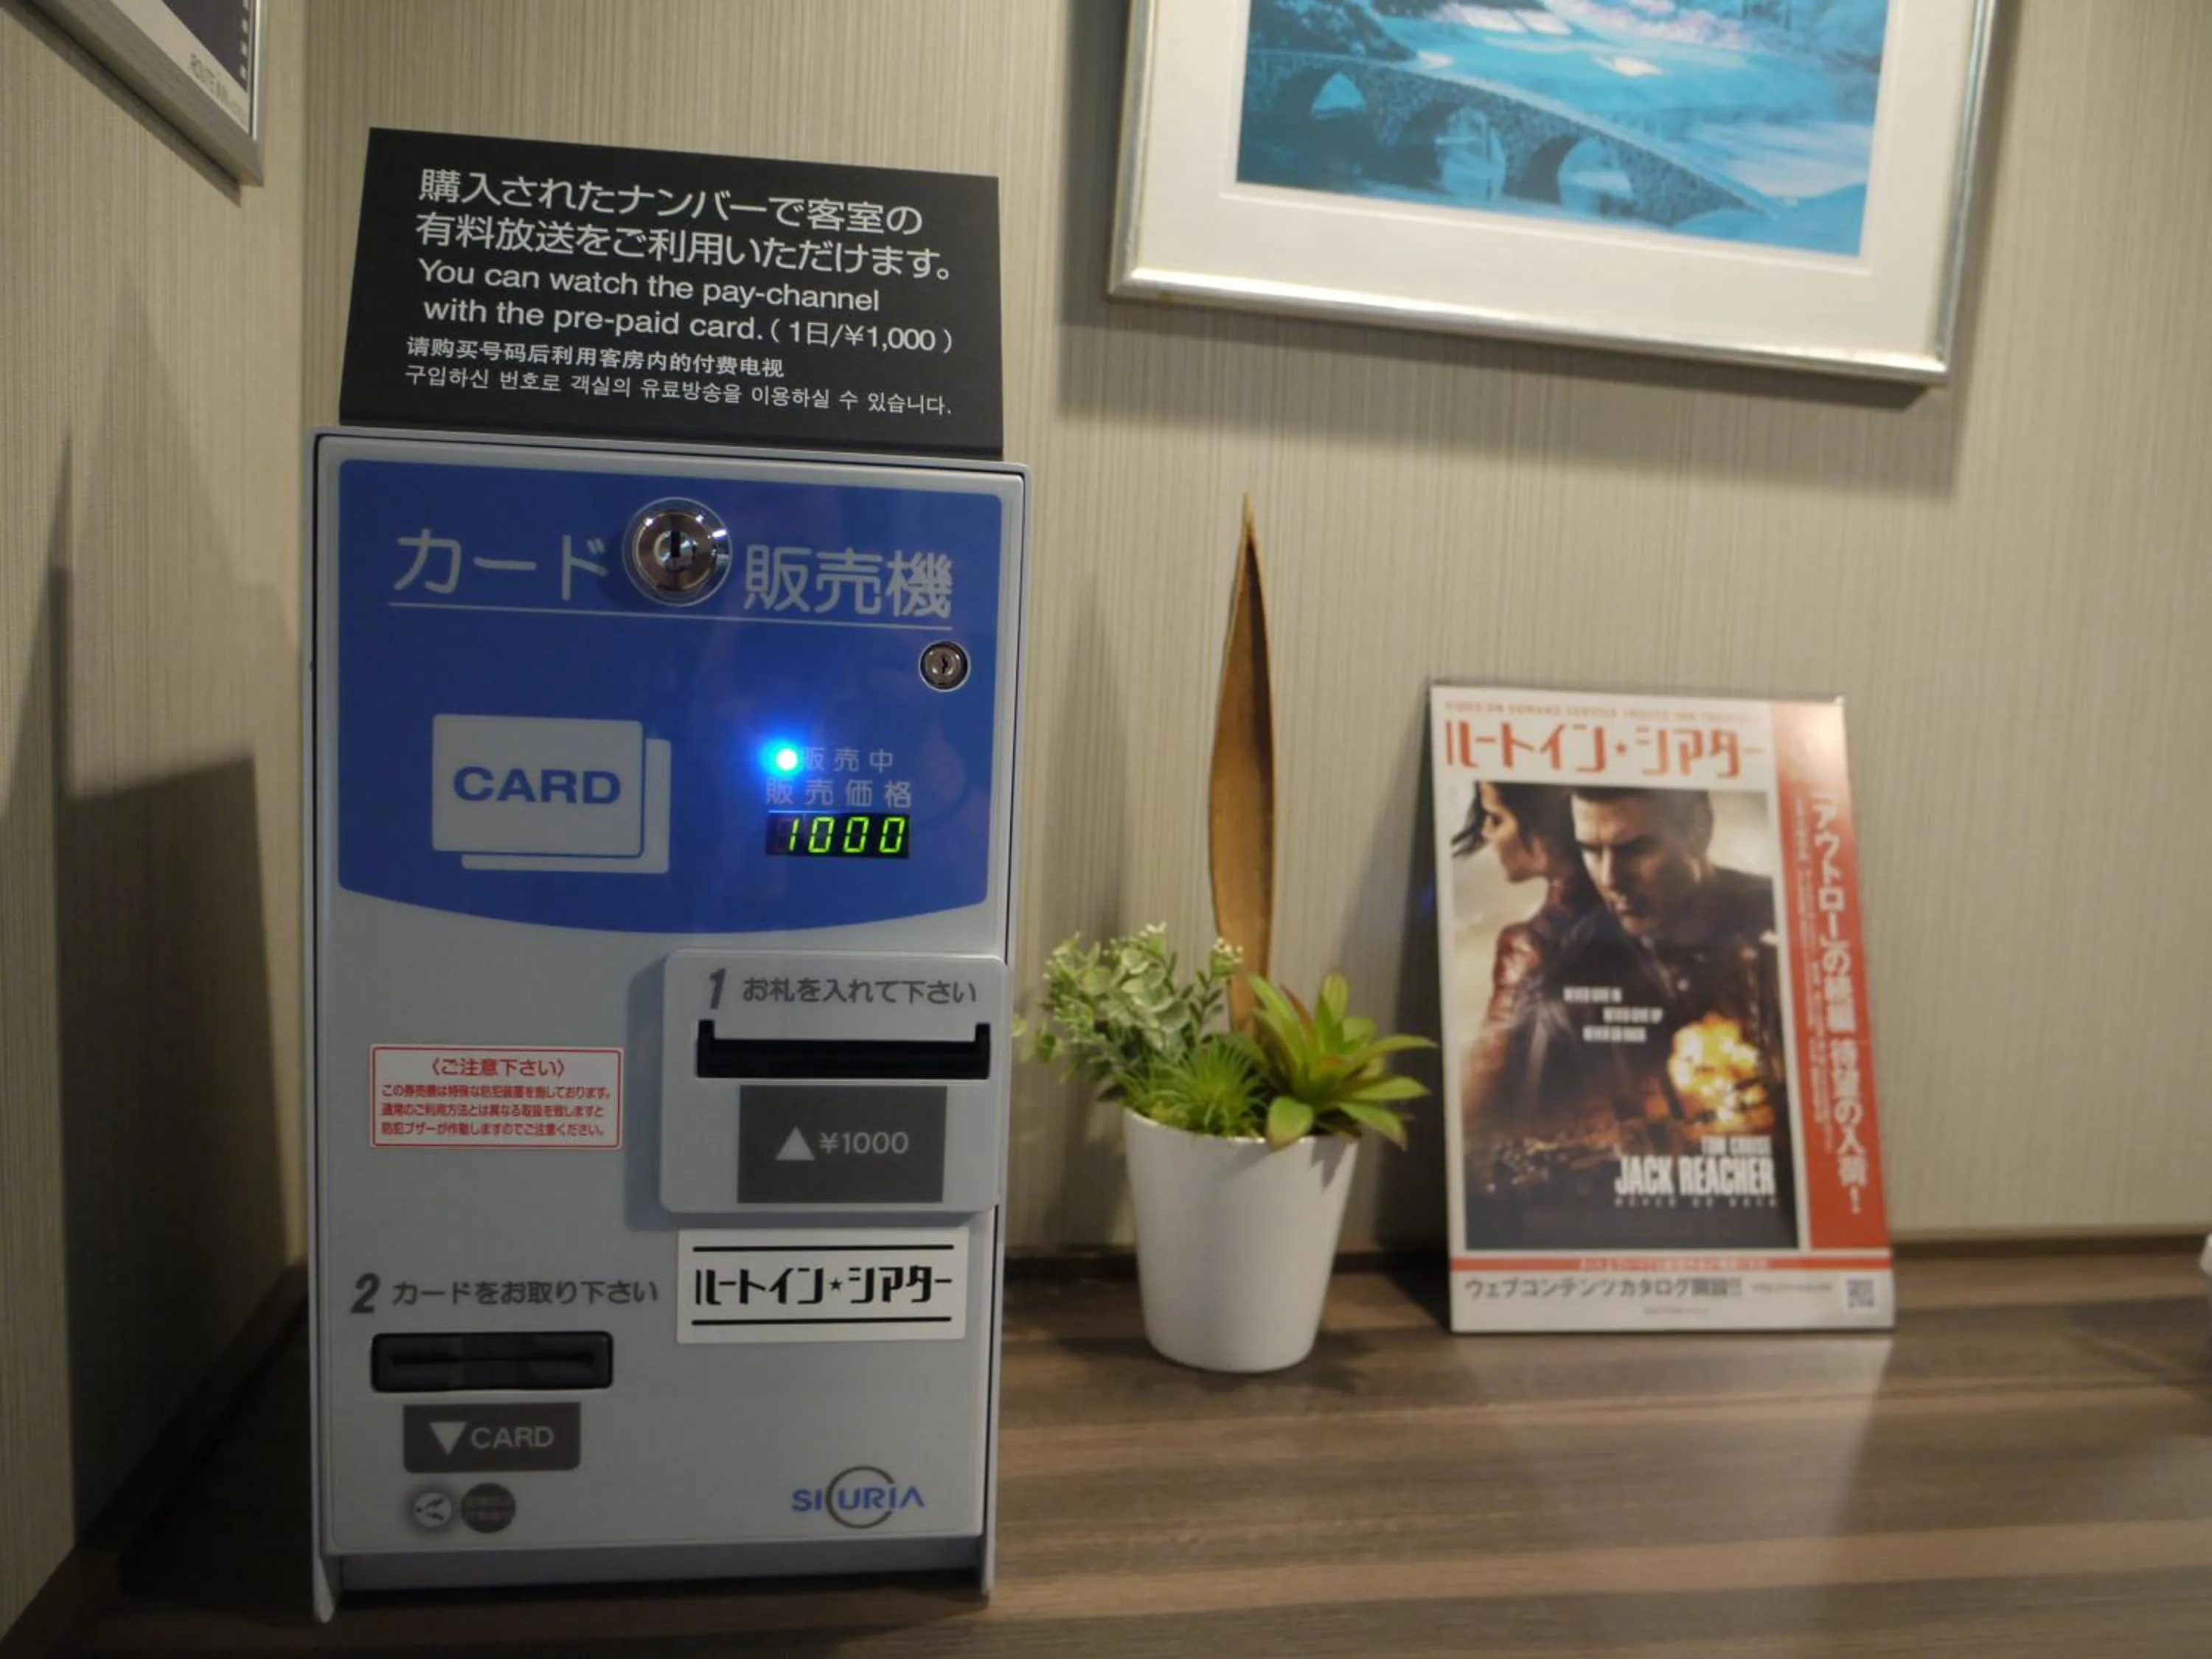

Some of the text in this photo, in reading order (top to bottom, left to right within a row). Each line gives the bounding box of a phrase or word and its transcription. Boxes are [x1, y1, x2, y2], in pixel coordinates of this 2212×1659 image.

[417, 168, 923, 236] 購入されたナンバーで客室の
[415, 211, 950, 280] 有料放送をご利用いただけます。
[418, 257, 880, 313] You can watch the pay-channel
[423, 297, 487, 324] with
[496, 300, 545, 327] the
[553, 307, 680, 337] pre-paid
[406, 335, 785, 378] 请购买号码后利用客房内的付费电视
[405, 364, 952, 415] 구입하신 번호로 객실의 유료방송을 이용하실 수 있습니다.
[392, 527, 953, 619] カード 販売機
[452, 765, 622, 805] CARD
[765, 776, 912, 810] 販売価格
[789, 815, 906, 854] 1000
[709, 967, 977, 1010] 1 お札を入れて下さい
[819, 1130, 910, 1155] ¥1000
[1614, 1155, 1776, 1197] JACK REACHER
[350, 1273, 658, 1315] 2 カードをお取り下さい
[470, 1425, 554, 1450] CARD
